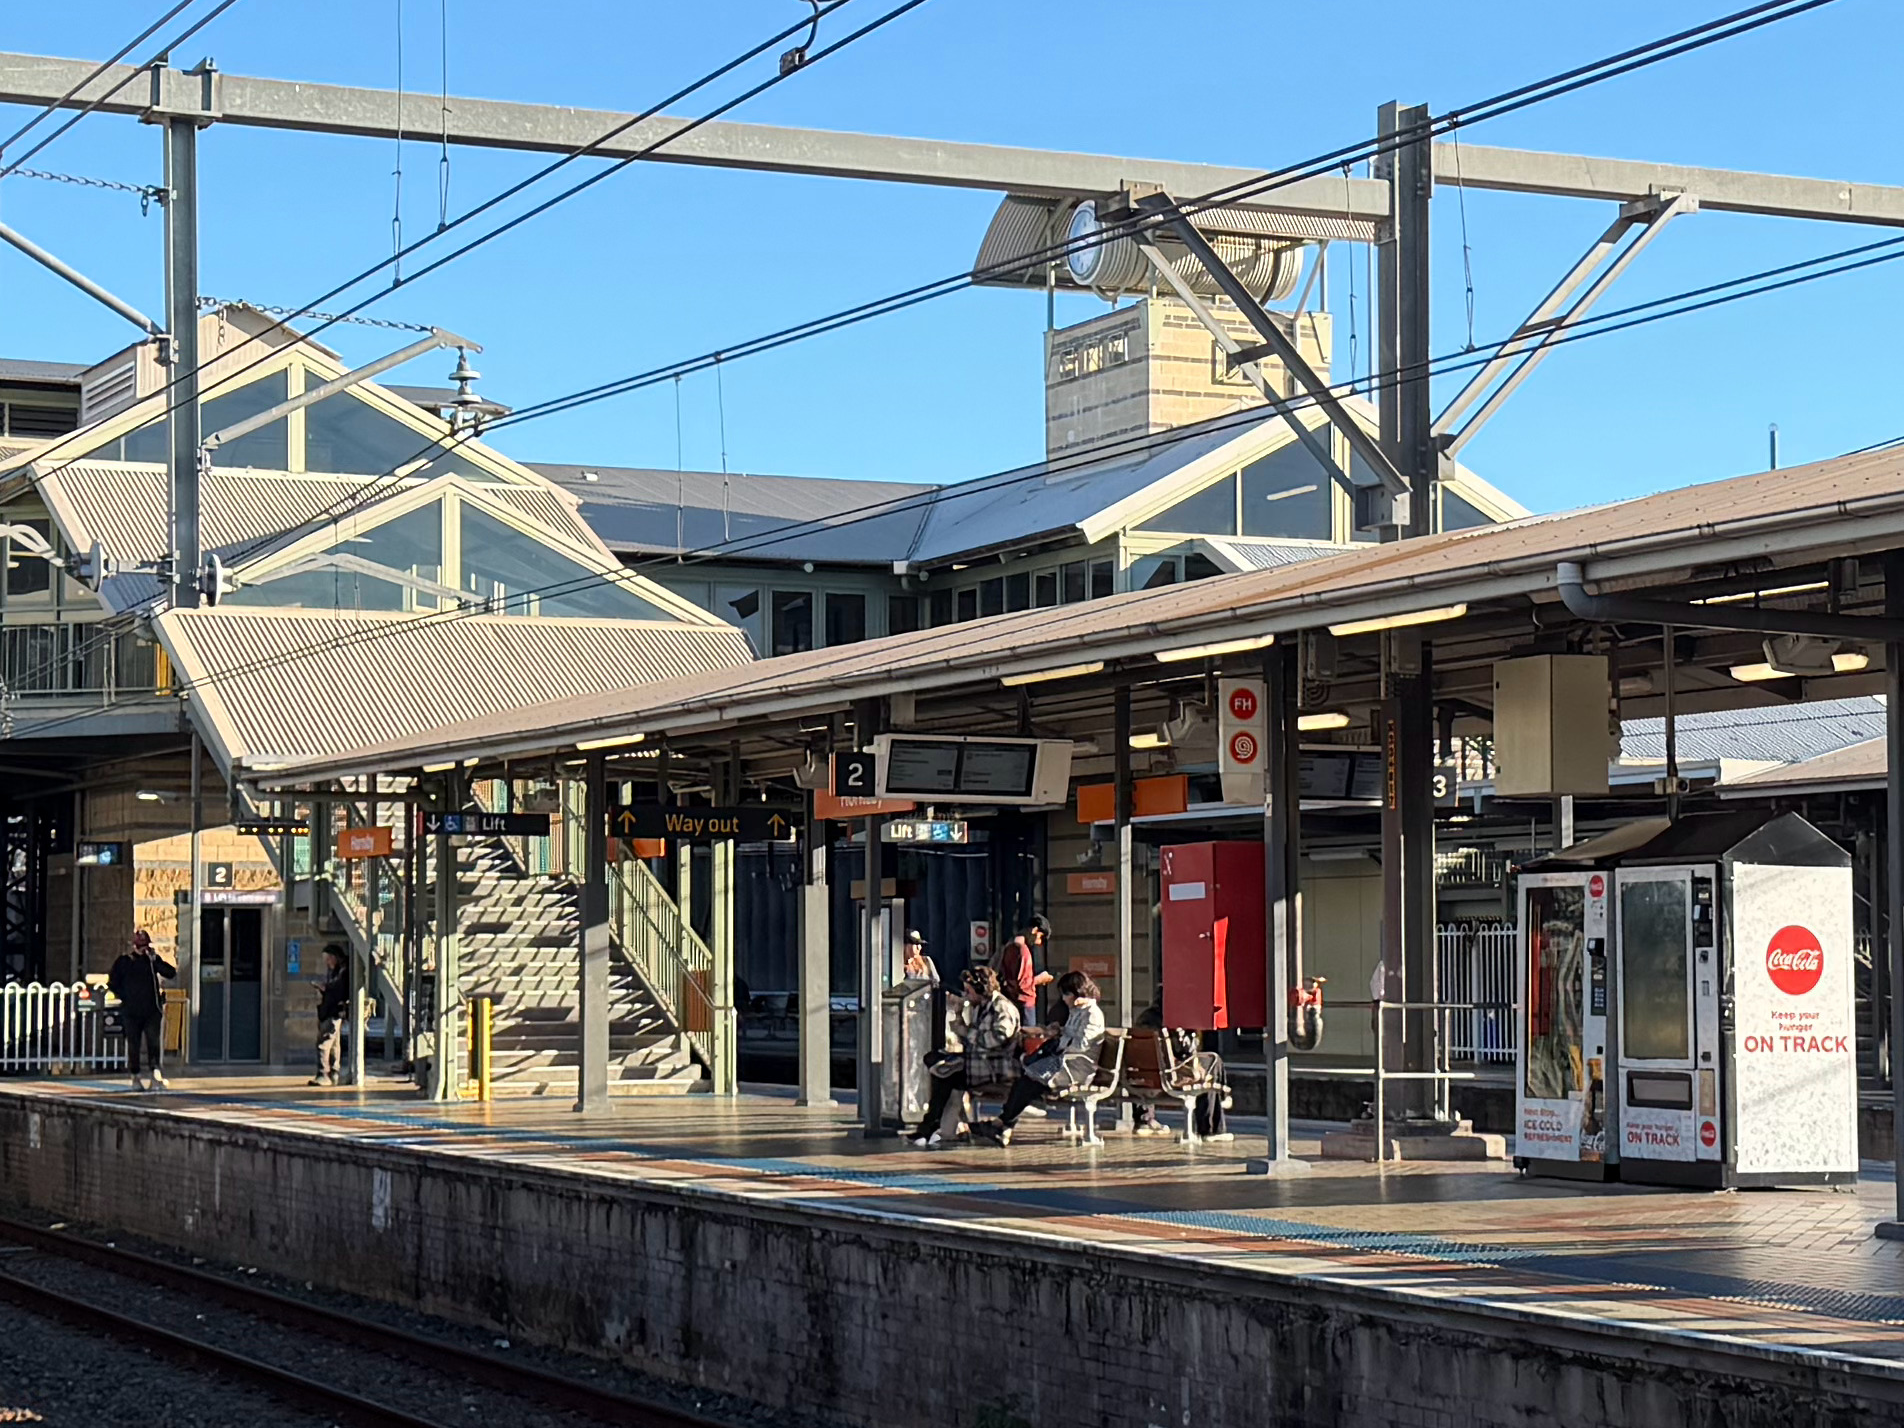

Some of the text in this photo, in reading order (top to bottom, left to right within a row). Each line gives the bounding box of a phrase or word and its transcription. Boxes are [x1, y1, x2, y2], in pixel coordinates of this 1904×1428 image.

[1234, 698, 1252, 711] FH
[848, 763, 863, 786] 2
[1432, 775, 1447, 797] 3
[483, 817, 506, 831] Lift
[665, 813, 739, 834] Way out
[891, 824, 913, 839] Lift
[215, 867, 226, 883] 2
[1744, 1035, 1848, 1053] ON TRACK
[1627, 1131, 1680, 1146] ON TRACK
